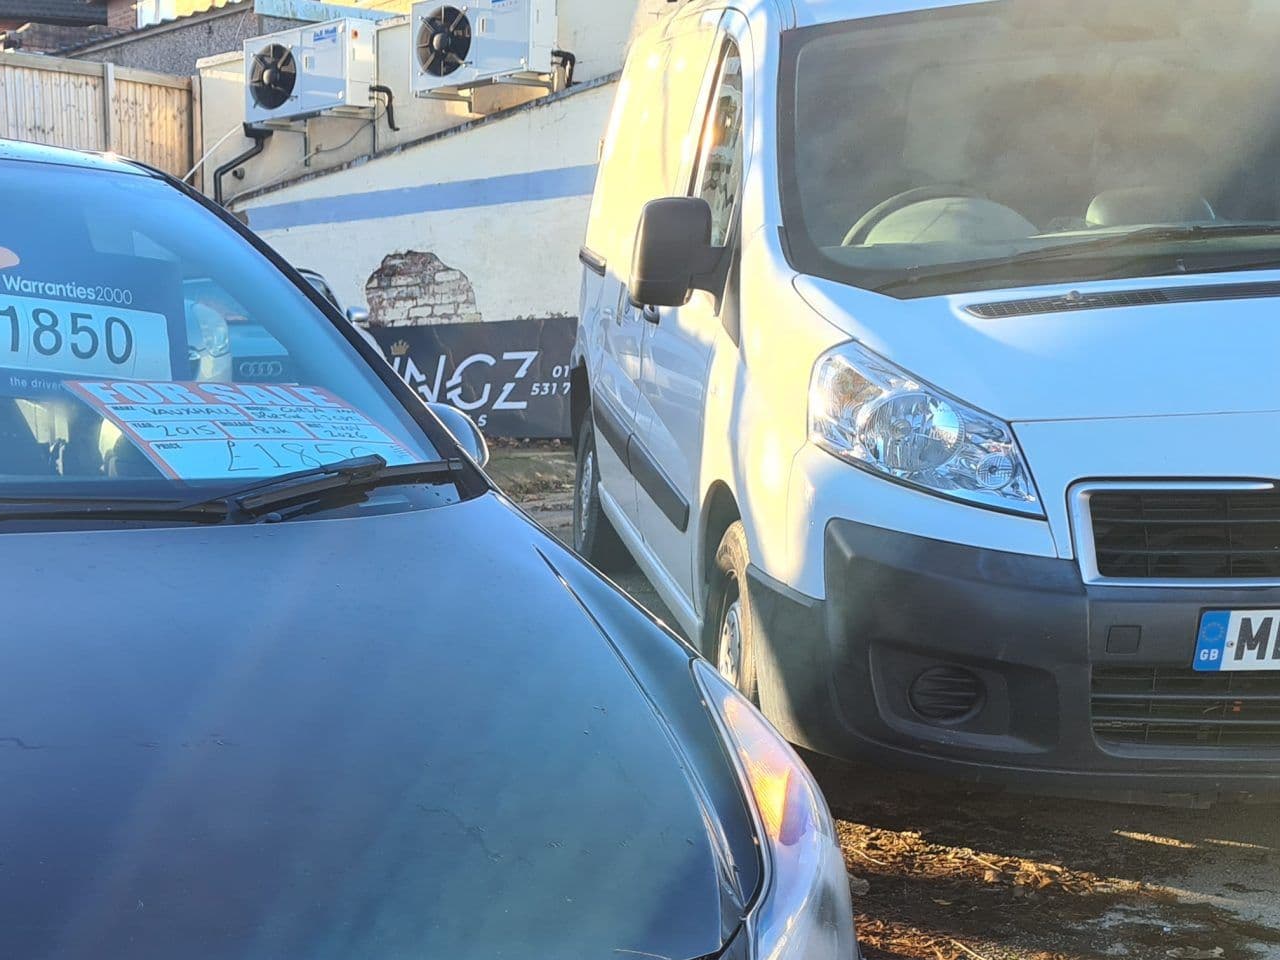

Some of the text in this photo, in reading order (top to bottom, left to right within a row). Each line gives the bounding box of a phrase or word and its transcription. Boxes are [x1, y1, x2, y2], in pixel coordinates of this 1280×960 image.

[2, 273, 134, 306] Warranties2000
[9, 376, 28, 387] the
[78, 382, 343, 408] FOR SALE
[531, 382, 557, 395] 531
[140, 406, 240, 416] VAUXHALL
[156, 425, 216, 437] 2015
[1200, 648, 1219, 661] GB
